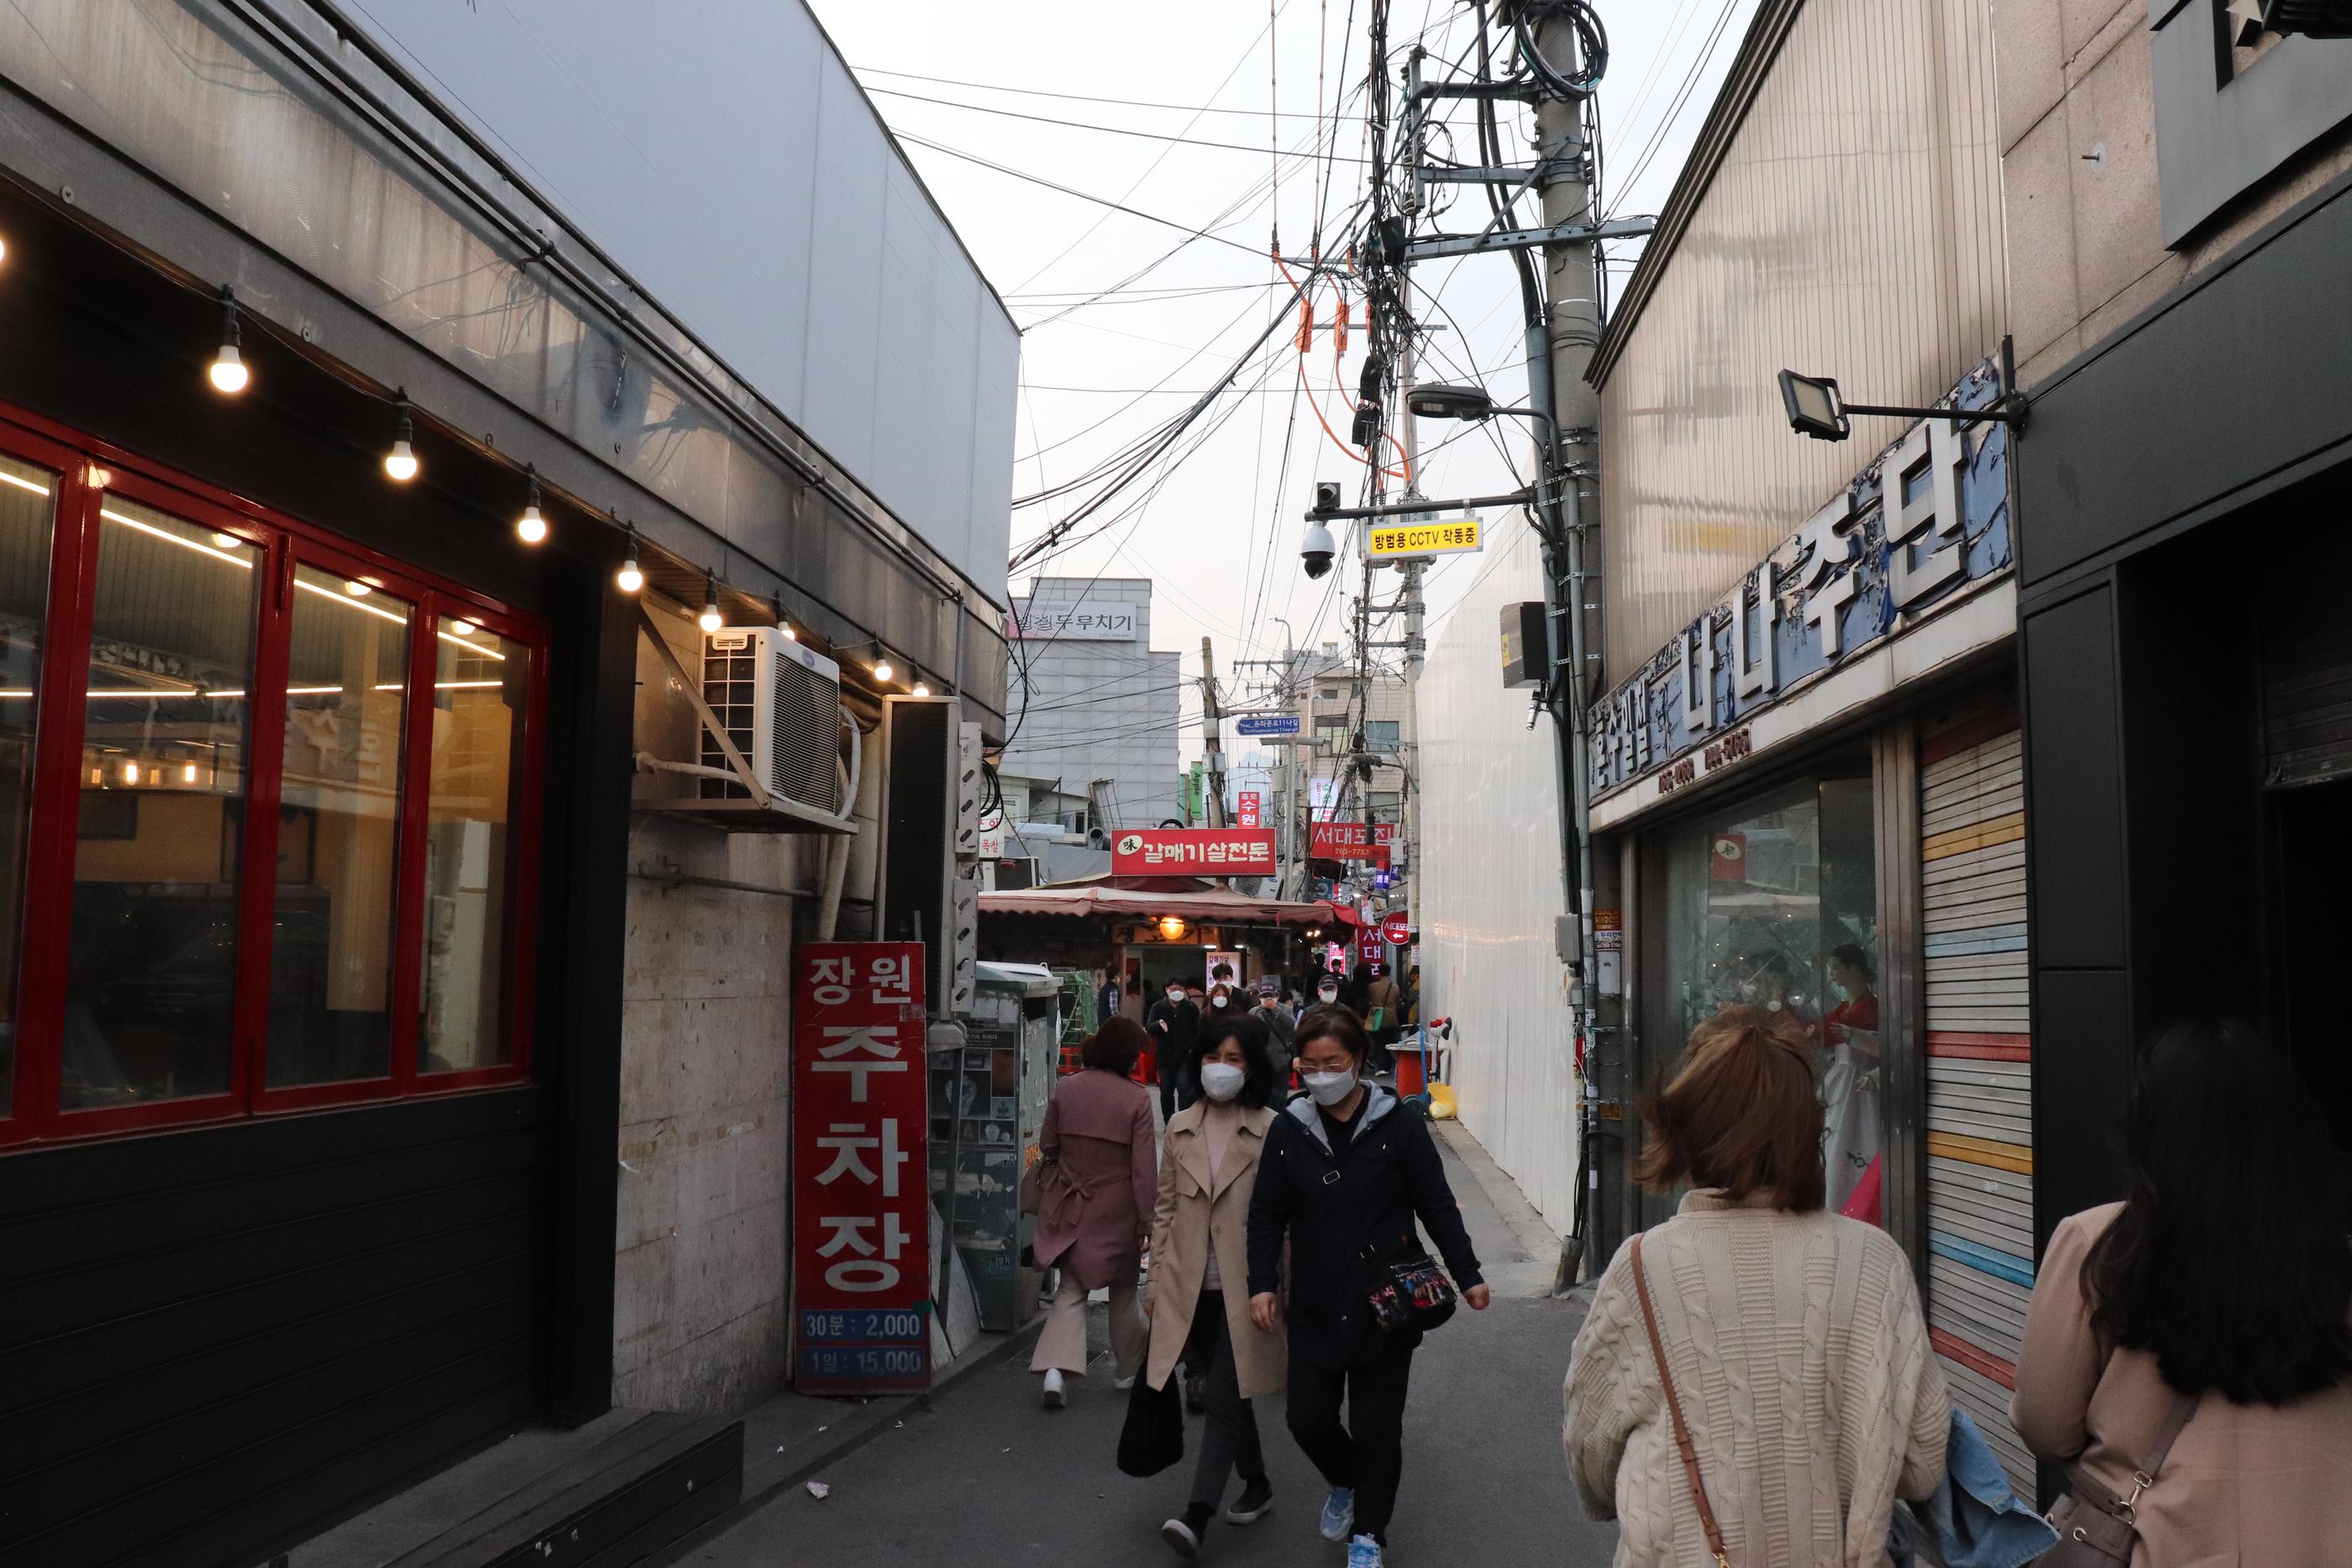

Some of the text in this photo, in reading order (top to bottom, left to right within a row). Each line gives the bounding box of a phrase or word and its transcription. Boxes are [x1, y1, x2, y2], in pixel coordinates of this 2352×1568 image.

[1375, 527, 1475, 549] 방범용 CCTV 작동중
[1681, 402, 1968, 732] 나나주단
[1192, 773, 1201, 796] Apple
[979, 818, 999, 831] 이
[1242, 800, 1257, 826] 수원
[982, 839, 999, 853] 목살
[1123, 838, 1137, 851] 味
[1144, 842, 1269, 863] 갈매기살전문
[810, 954, 911, 1004] 장원
[811, 1025, 909, 1293] 주차장
[866, 1314, 920, 1339] 2,000
[858, 1351, 921, 1376] 15,000
